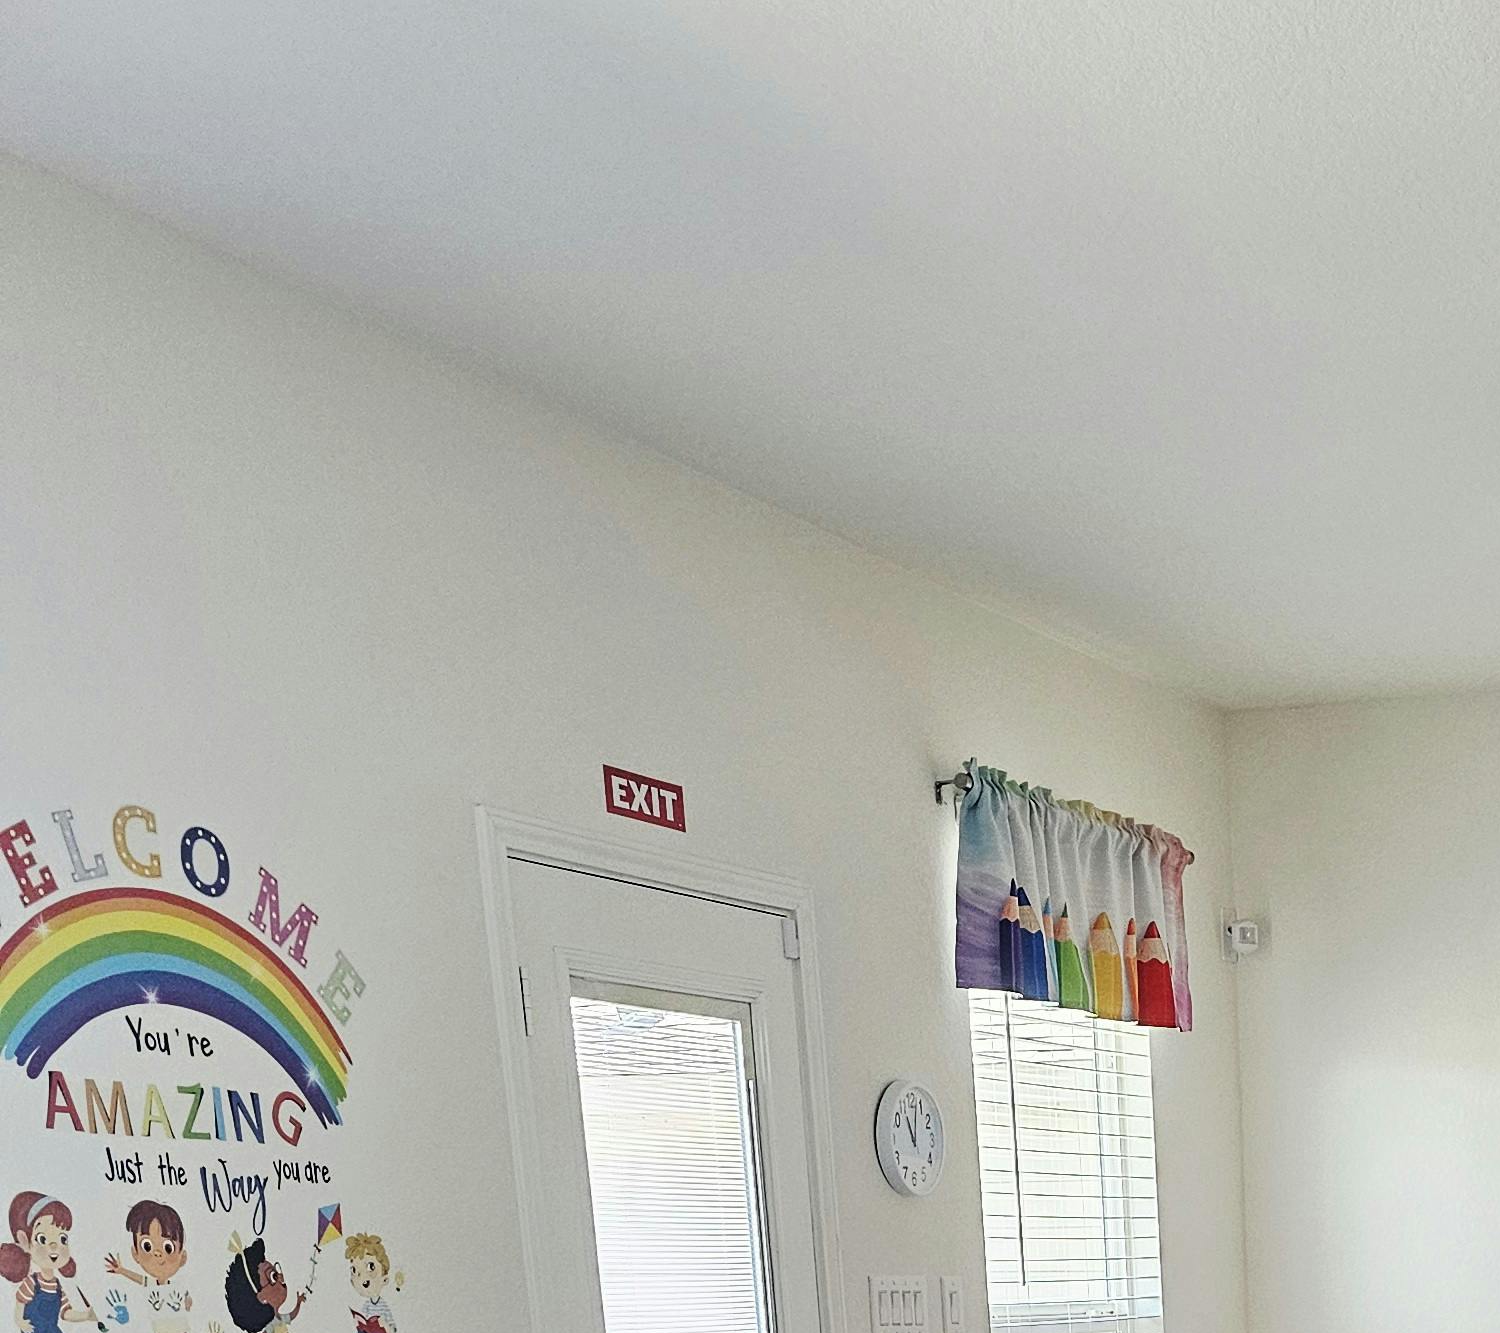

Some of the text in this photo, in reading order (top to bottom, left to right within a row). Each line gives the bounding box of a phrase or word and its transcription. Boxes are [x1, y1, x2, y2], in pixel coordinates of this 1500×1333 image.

[609, 774, 679, 822] EXIT
[0, 804, 367, 1027] ELCOME
[125, 1015, 213, 1057] You're
[45, 1070, 307, 1147] AMAZING
[105, 1147, 331, 1236] Just the Way you are
